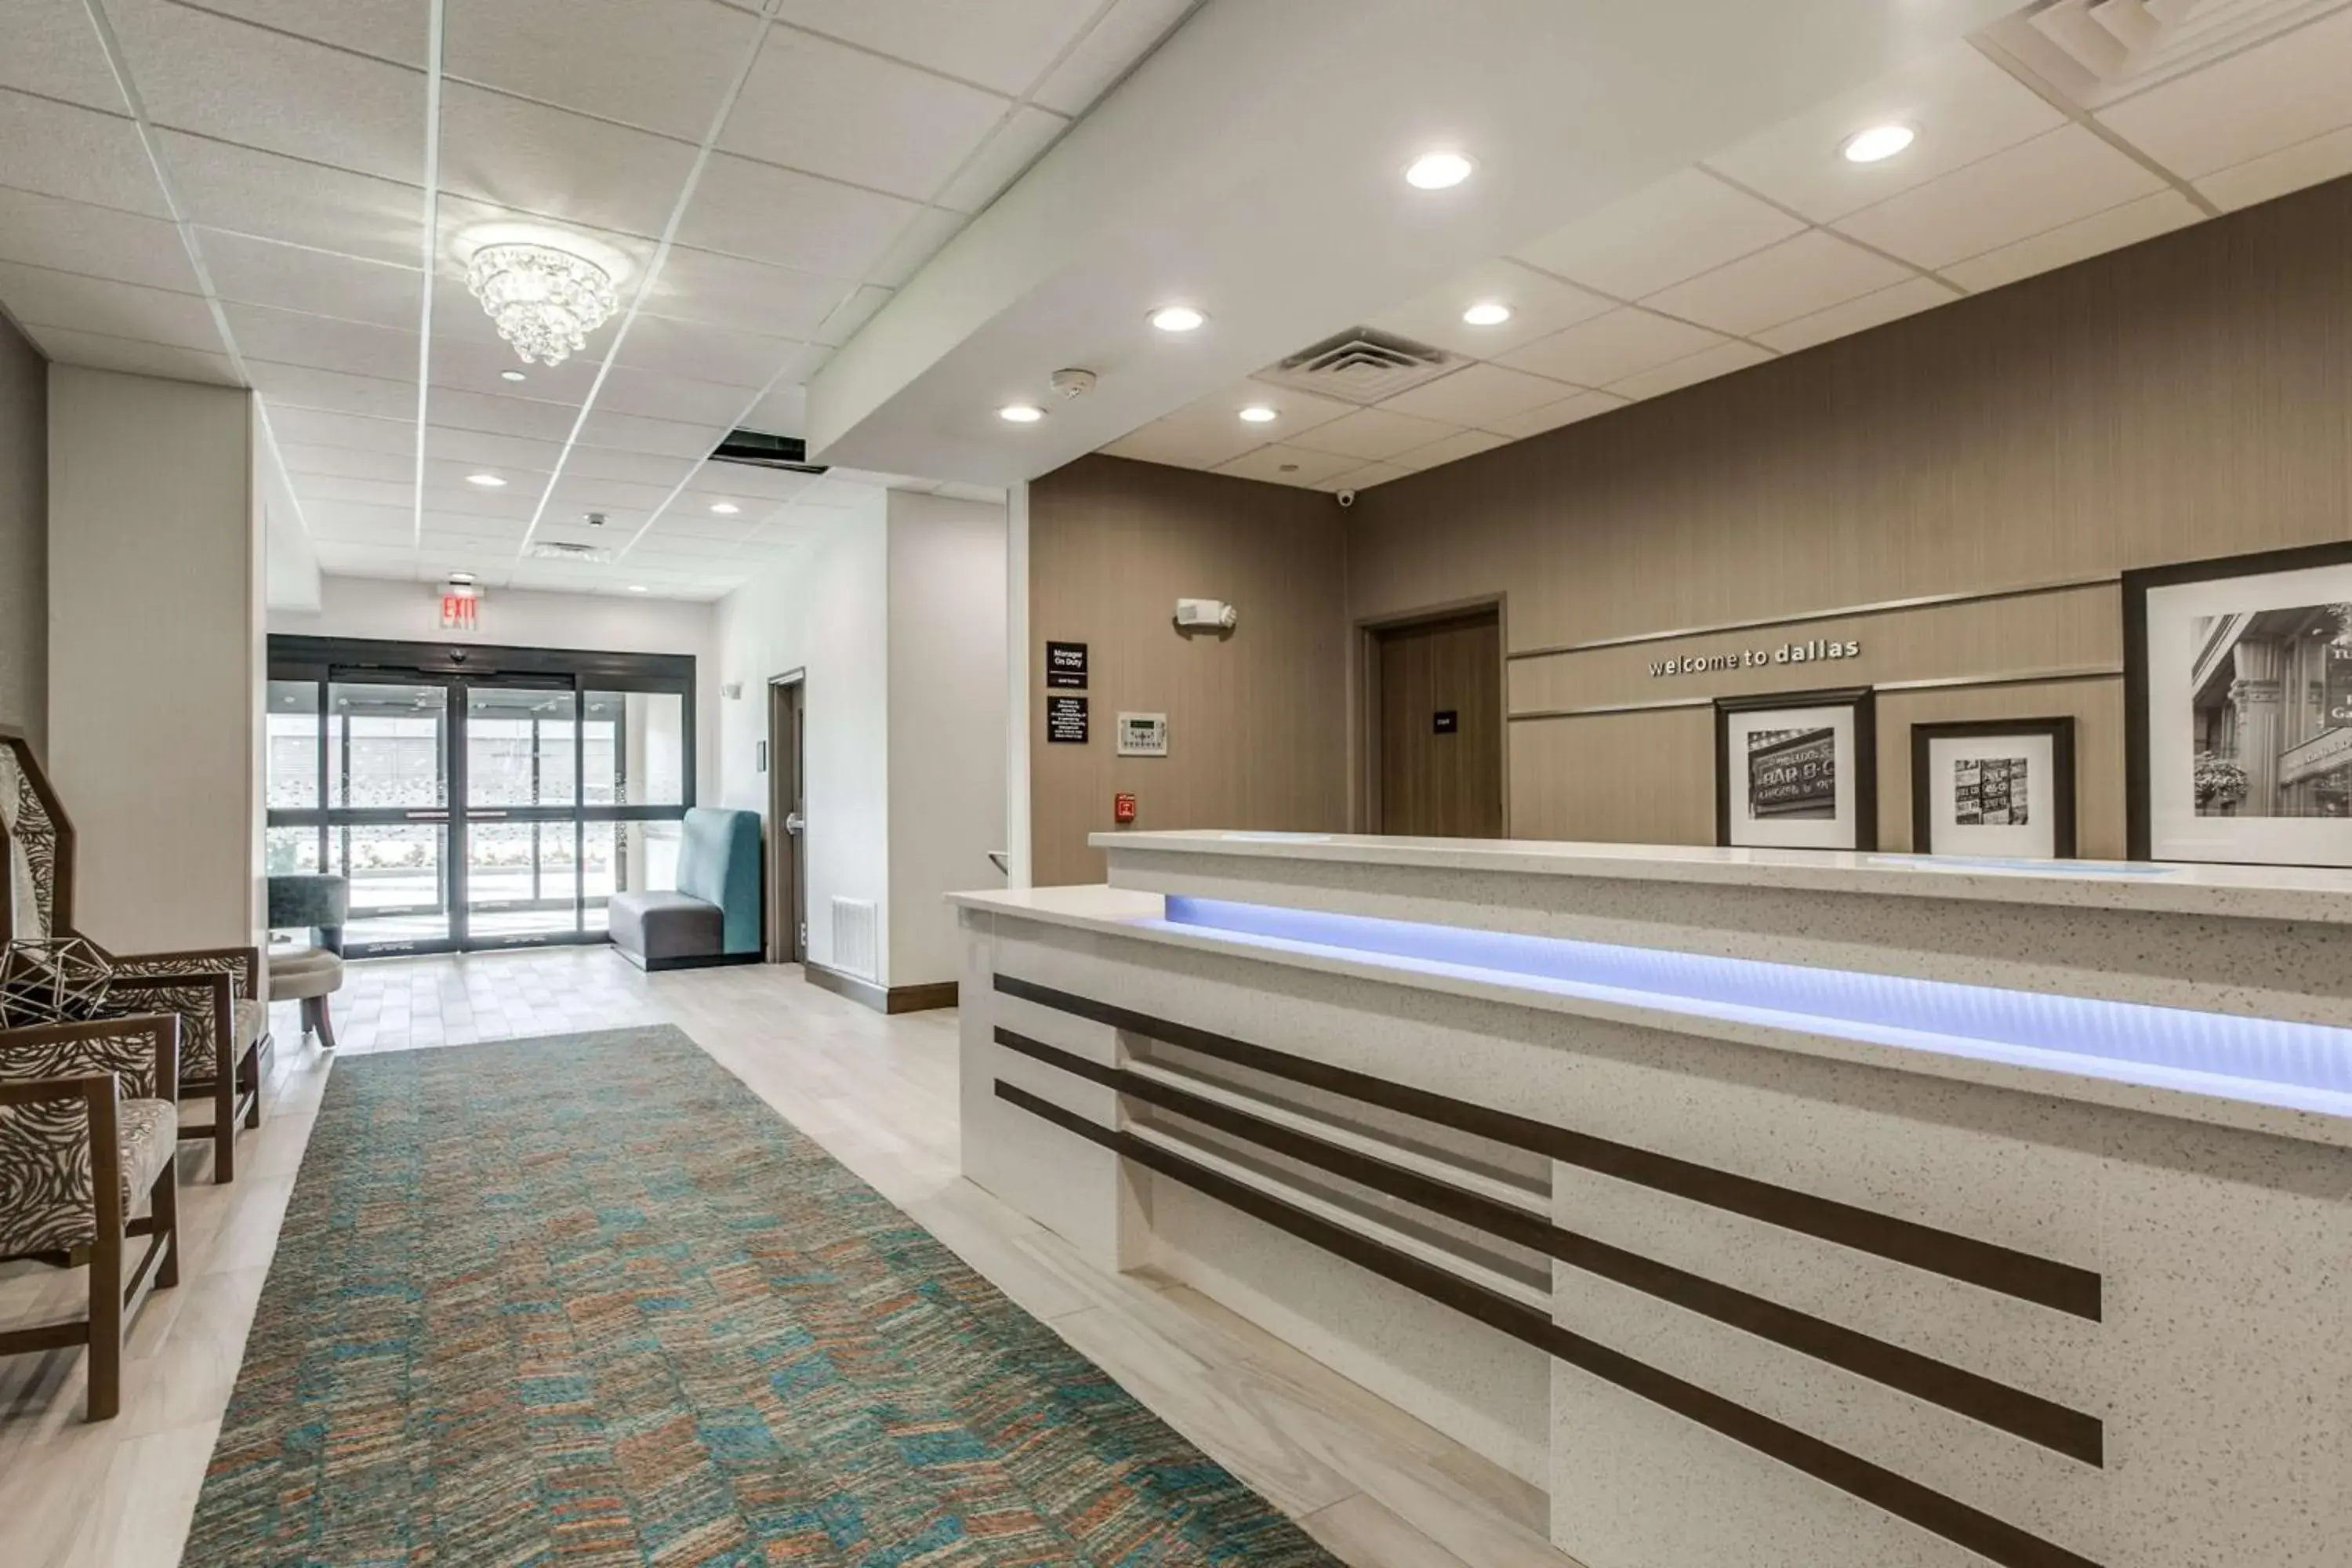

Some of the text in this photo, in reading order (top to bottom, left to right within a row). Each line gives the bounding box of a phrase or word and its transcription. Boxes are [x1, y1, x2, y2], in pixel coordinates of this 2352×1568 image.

[442, 597, 477, 619] EXIT
[1054, 649, 1083, 659] Manager
[1649, 639, 1860, 677] welcome to dallas
[1054, 657, 1083, 668] On Duty
